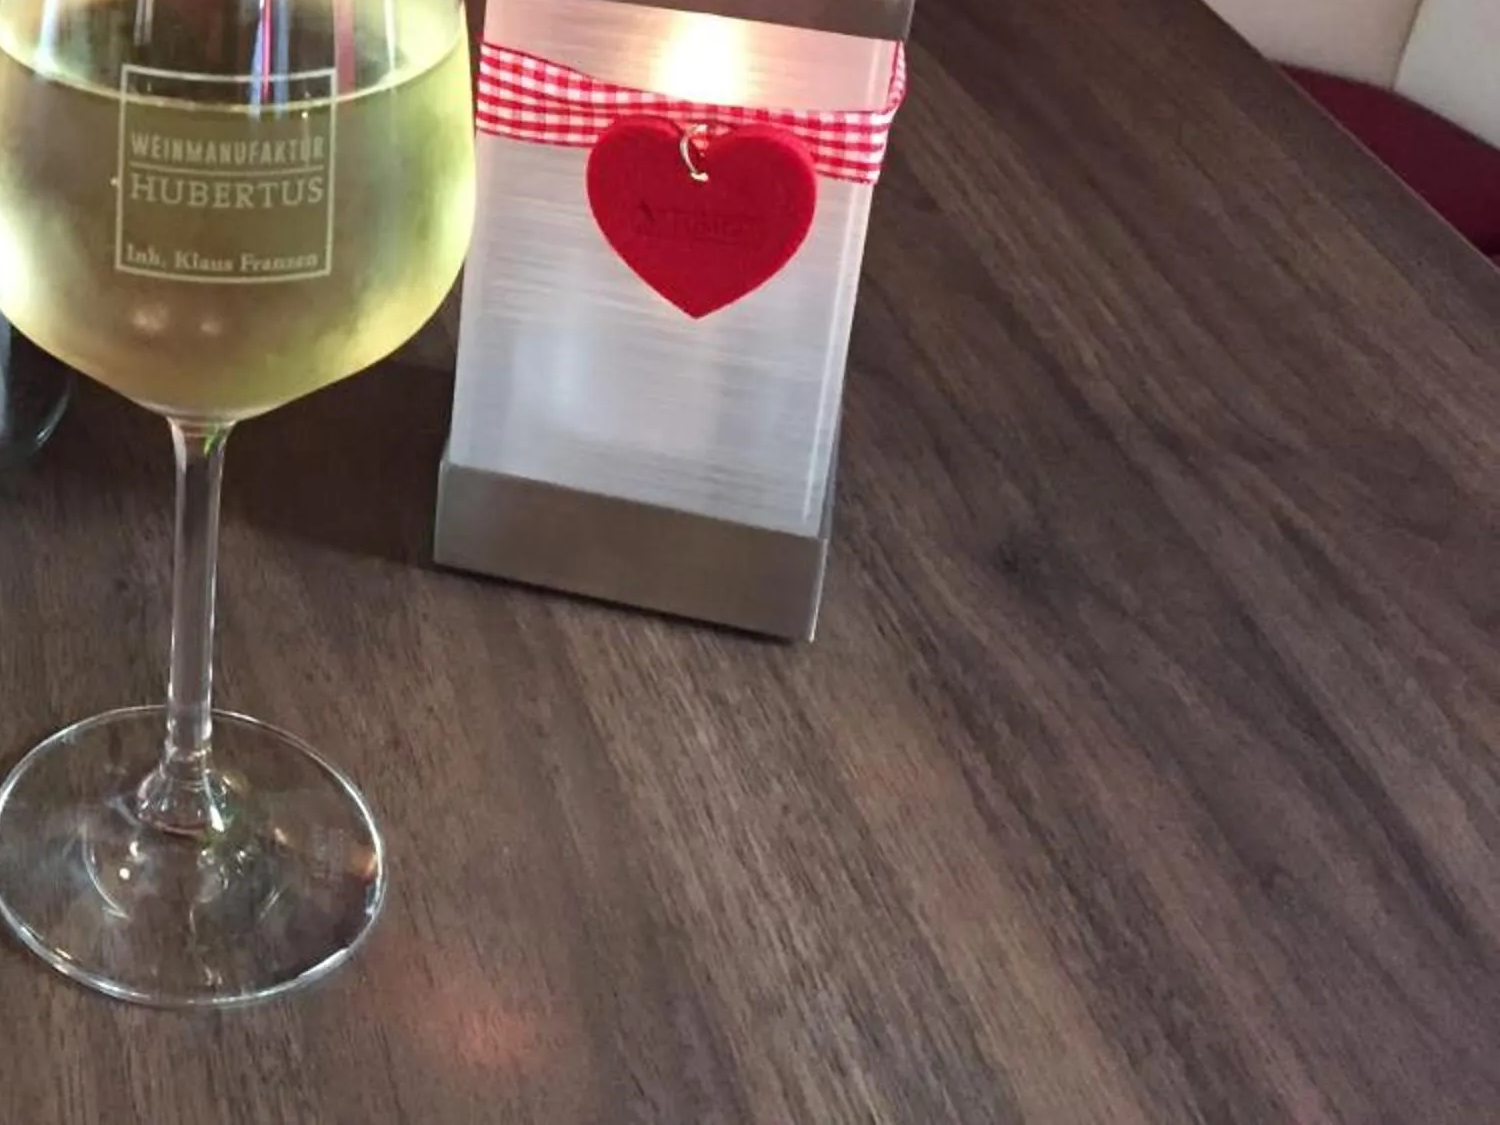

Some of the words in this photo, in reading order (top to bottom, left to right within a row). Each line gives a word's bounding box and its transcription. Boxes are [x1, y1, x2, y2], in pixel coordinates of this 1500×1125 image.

[130, 130, 325, 165] WEINMANUFAKTUR
[129, 172, 325, 209] HUBERTUS
[175, 250, 233, 272] Klaus
